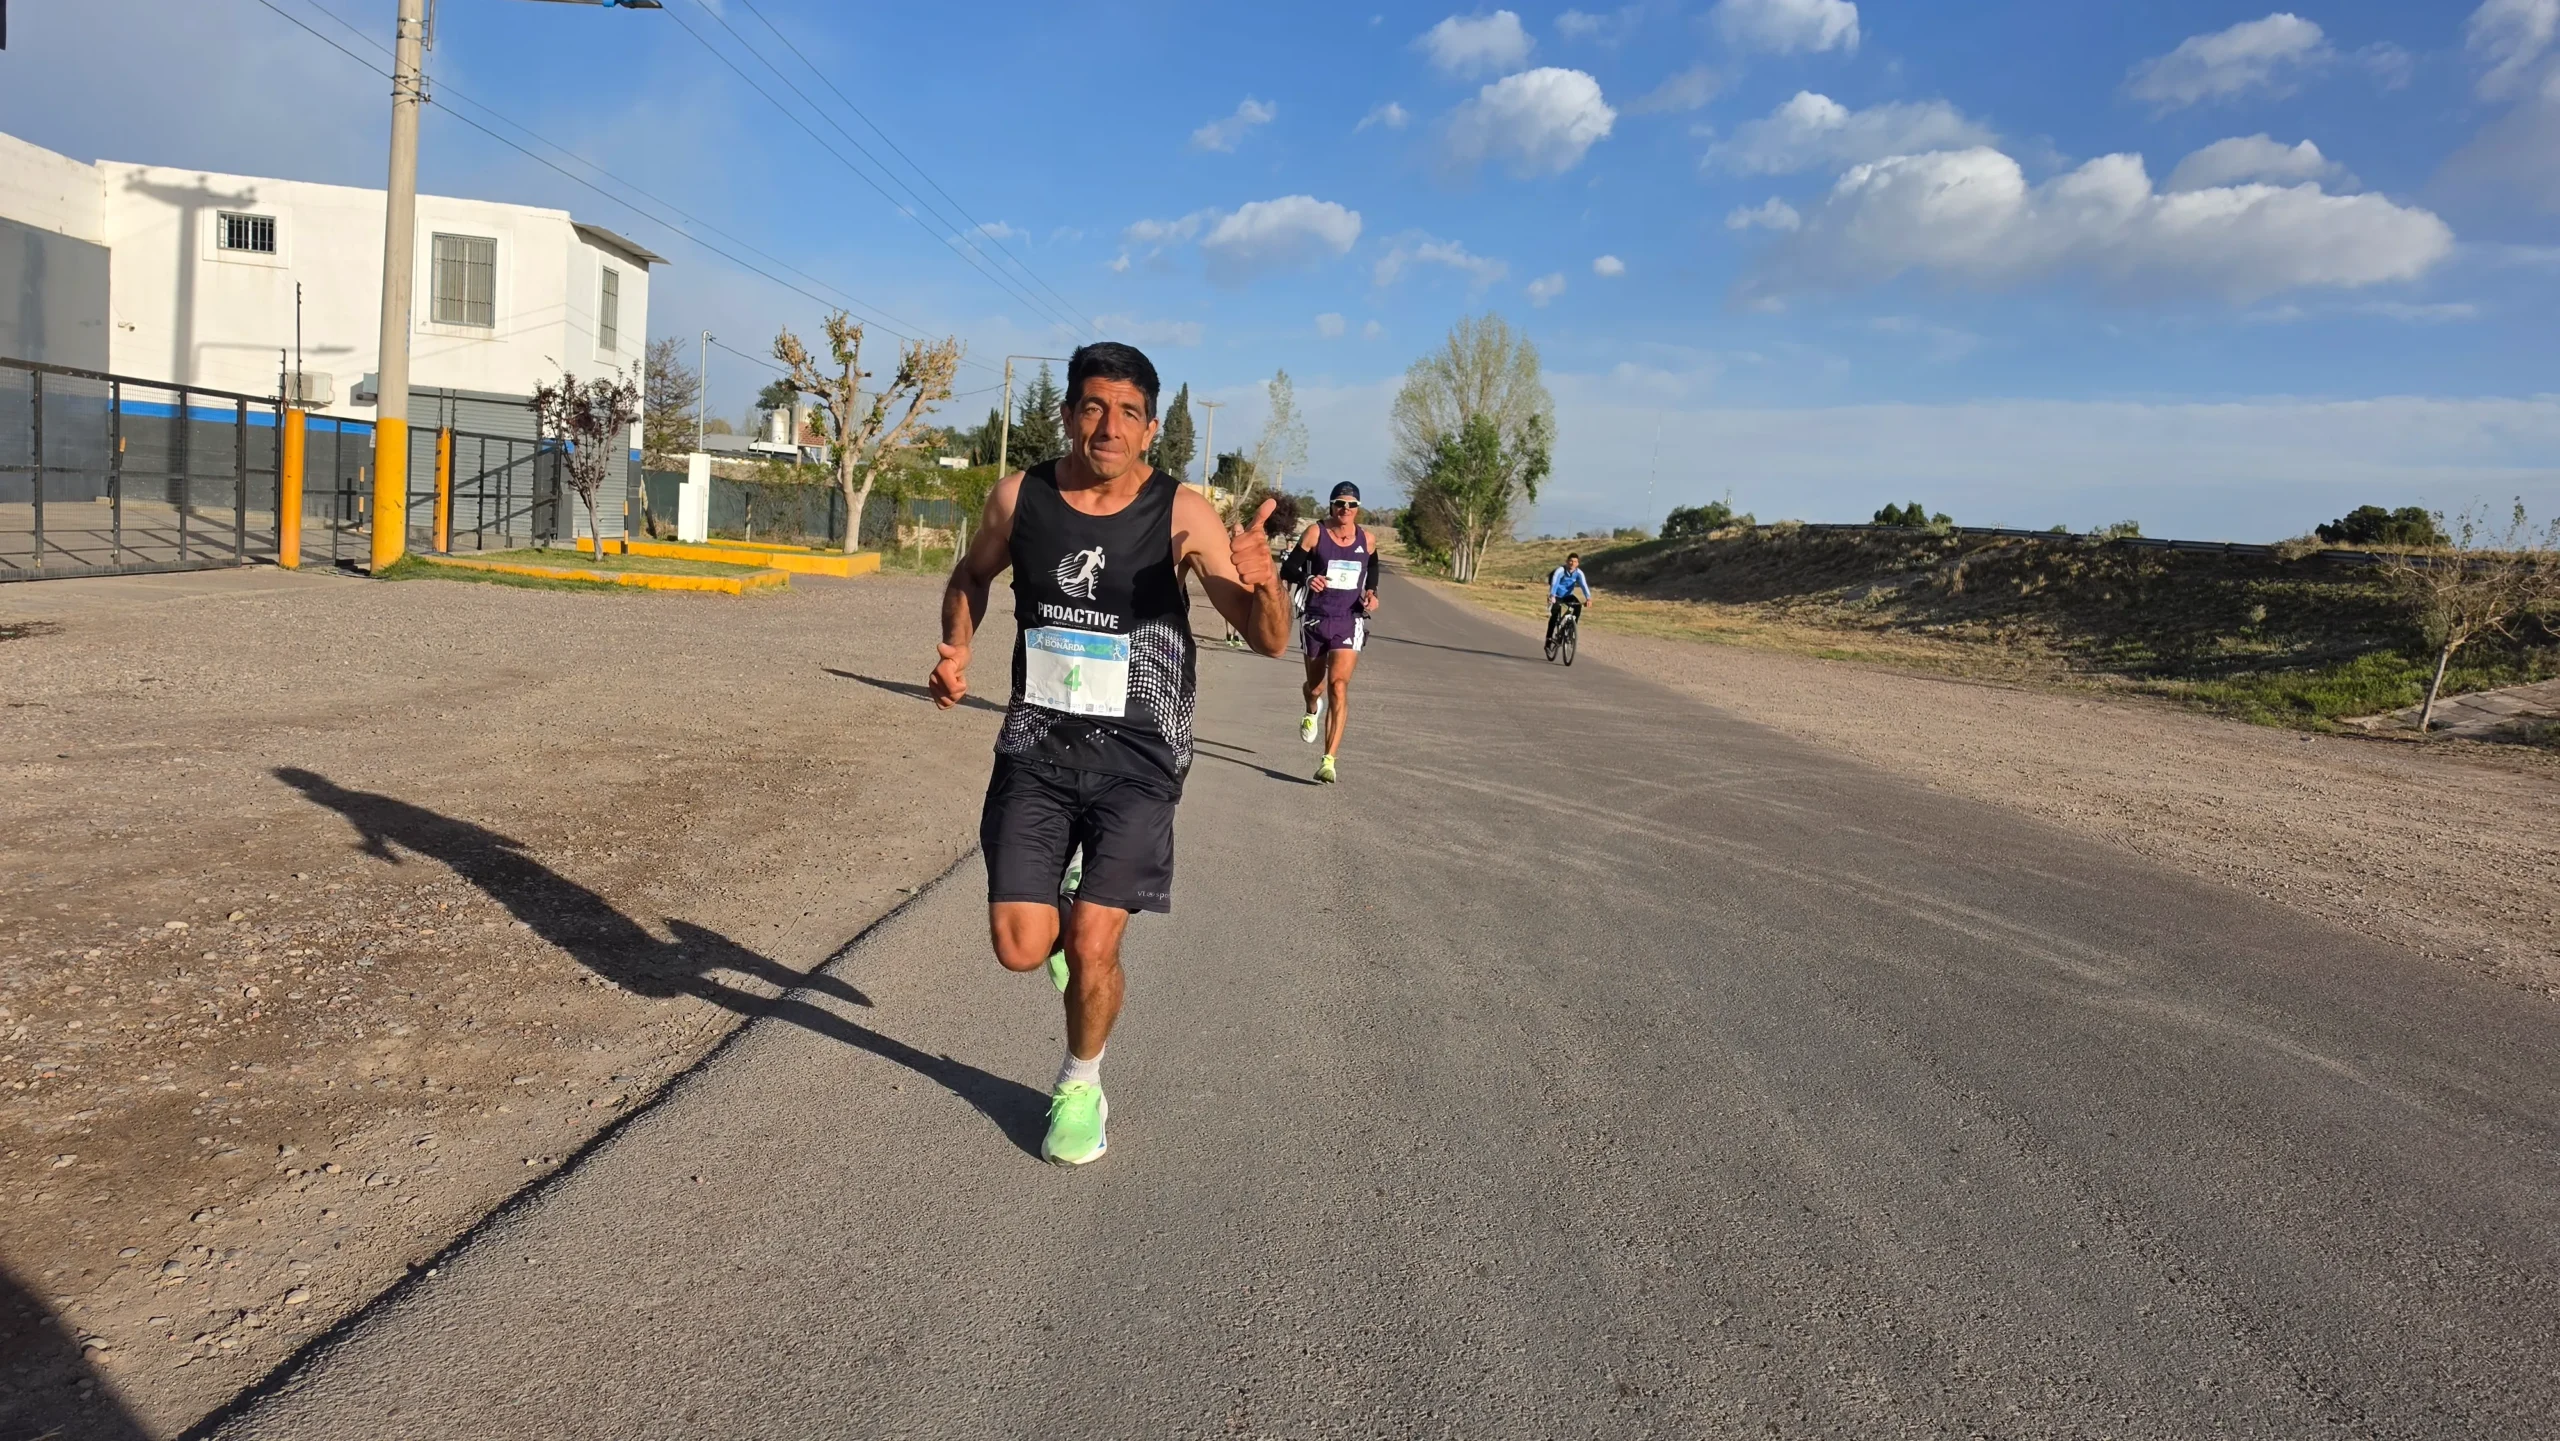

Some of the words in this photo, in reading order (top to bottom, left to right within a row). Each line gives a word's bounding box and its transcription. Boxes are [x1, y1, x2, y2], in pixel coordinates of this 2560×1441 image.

[1340, 572, 1347, 582] 5
[1038, 601, 1120, 630] PROACTIVE
[1045, 639, 1086, 652] BONARDA
[1063, 664, 1082, 691] 4
